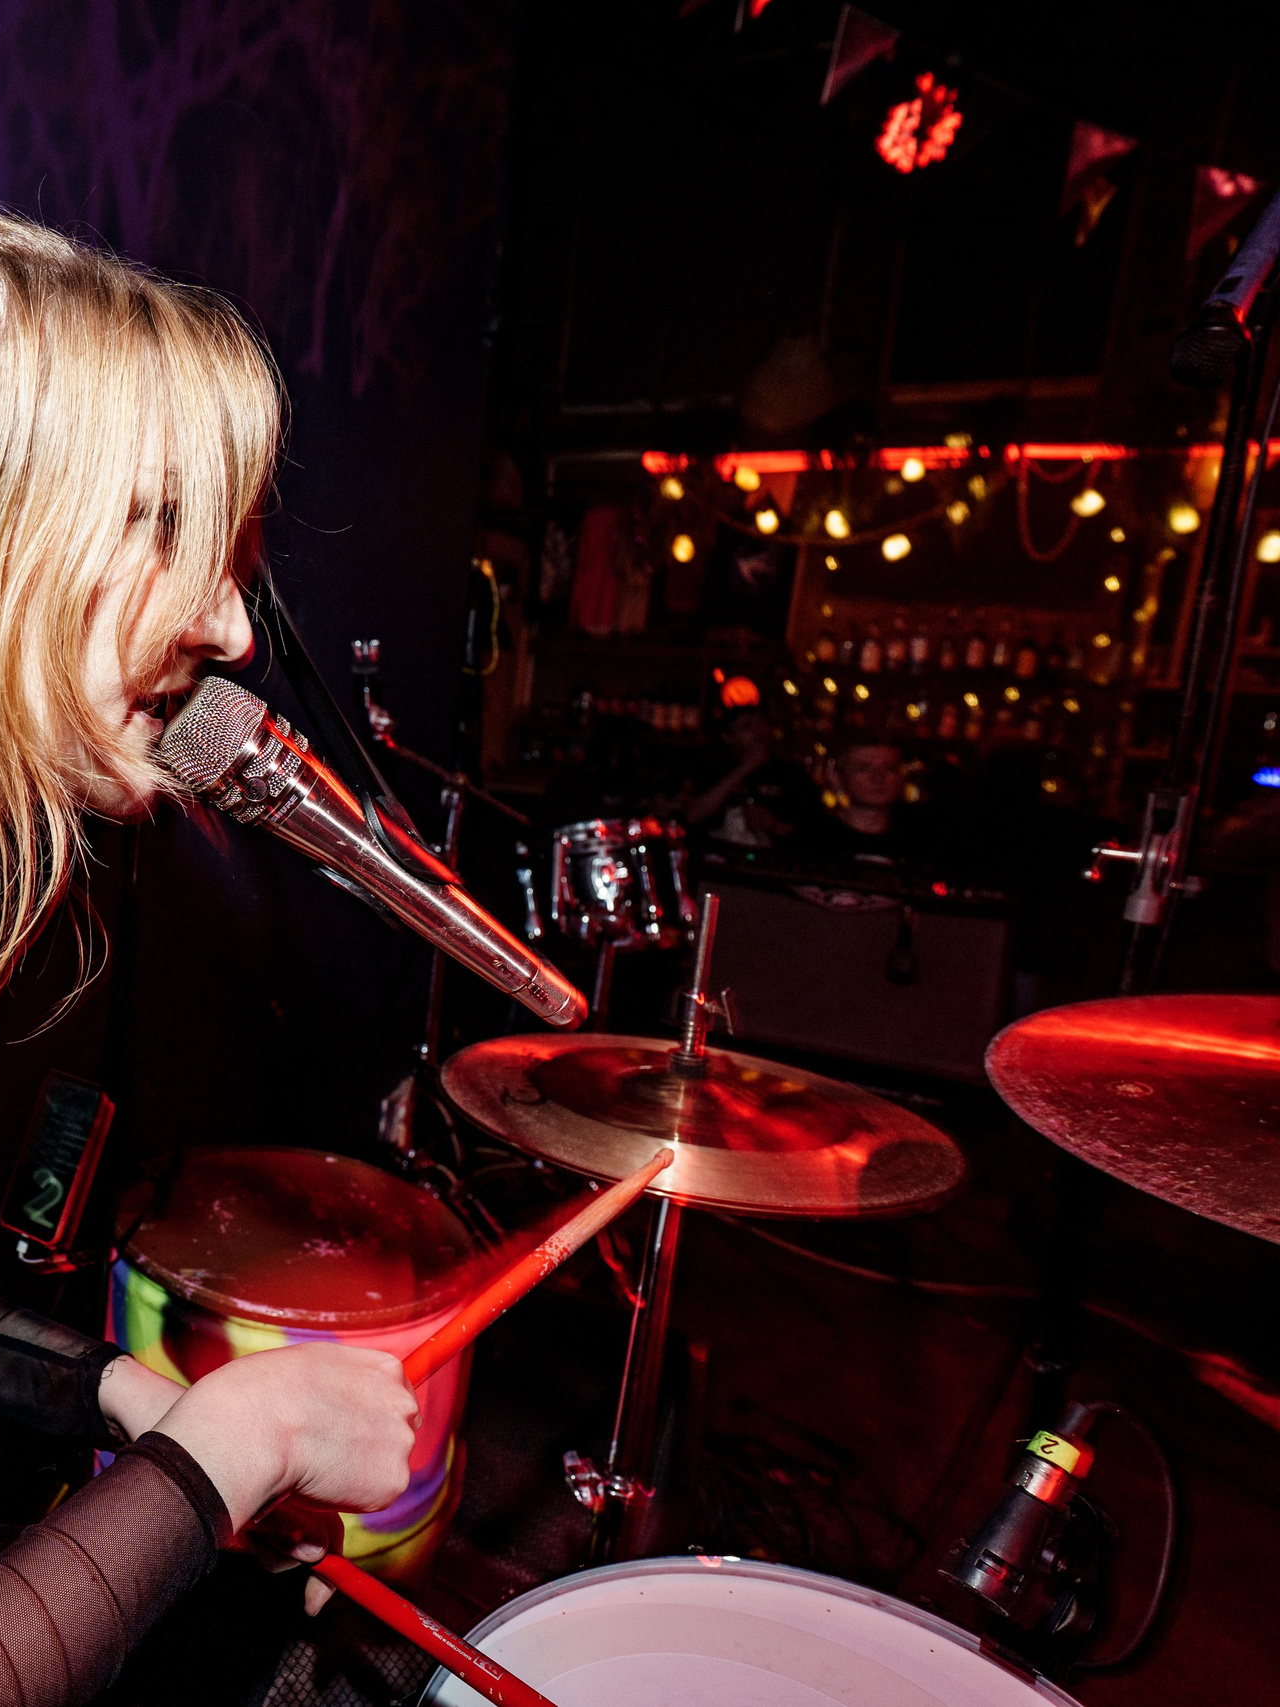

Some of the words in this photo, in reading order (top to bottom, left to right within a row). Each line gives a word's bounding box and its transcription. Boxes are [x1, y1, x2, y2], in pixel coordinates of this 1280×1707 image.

[270, 794, 298, 823] SHURE
[23, 1166, 64, 1229] 2
[1040, 1436, 1060, 1455] 2
